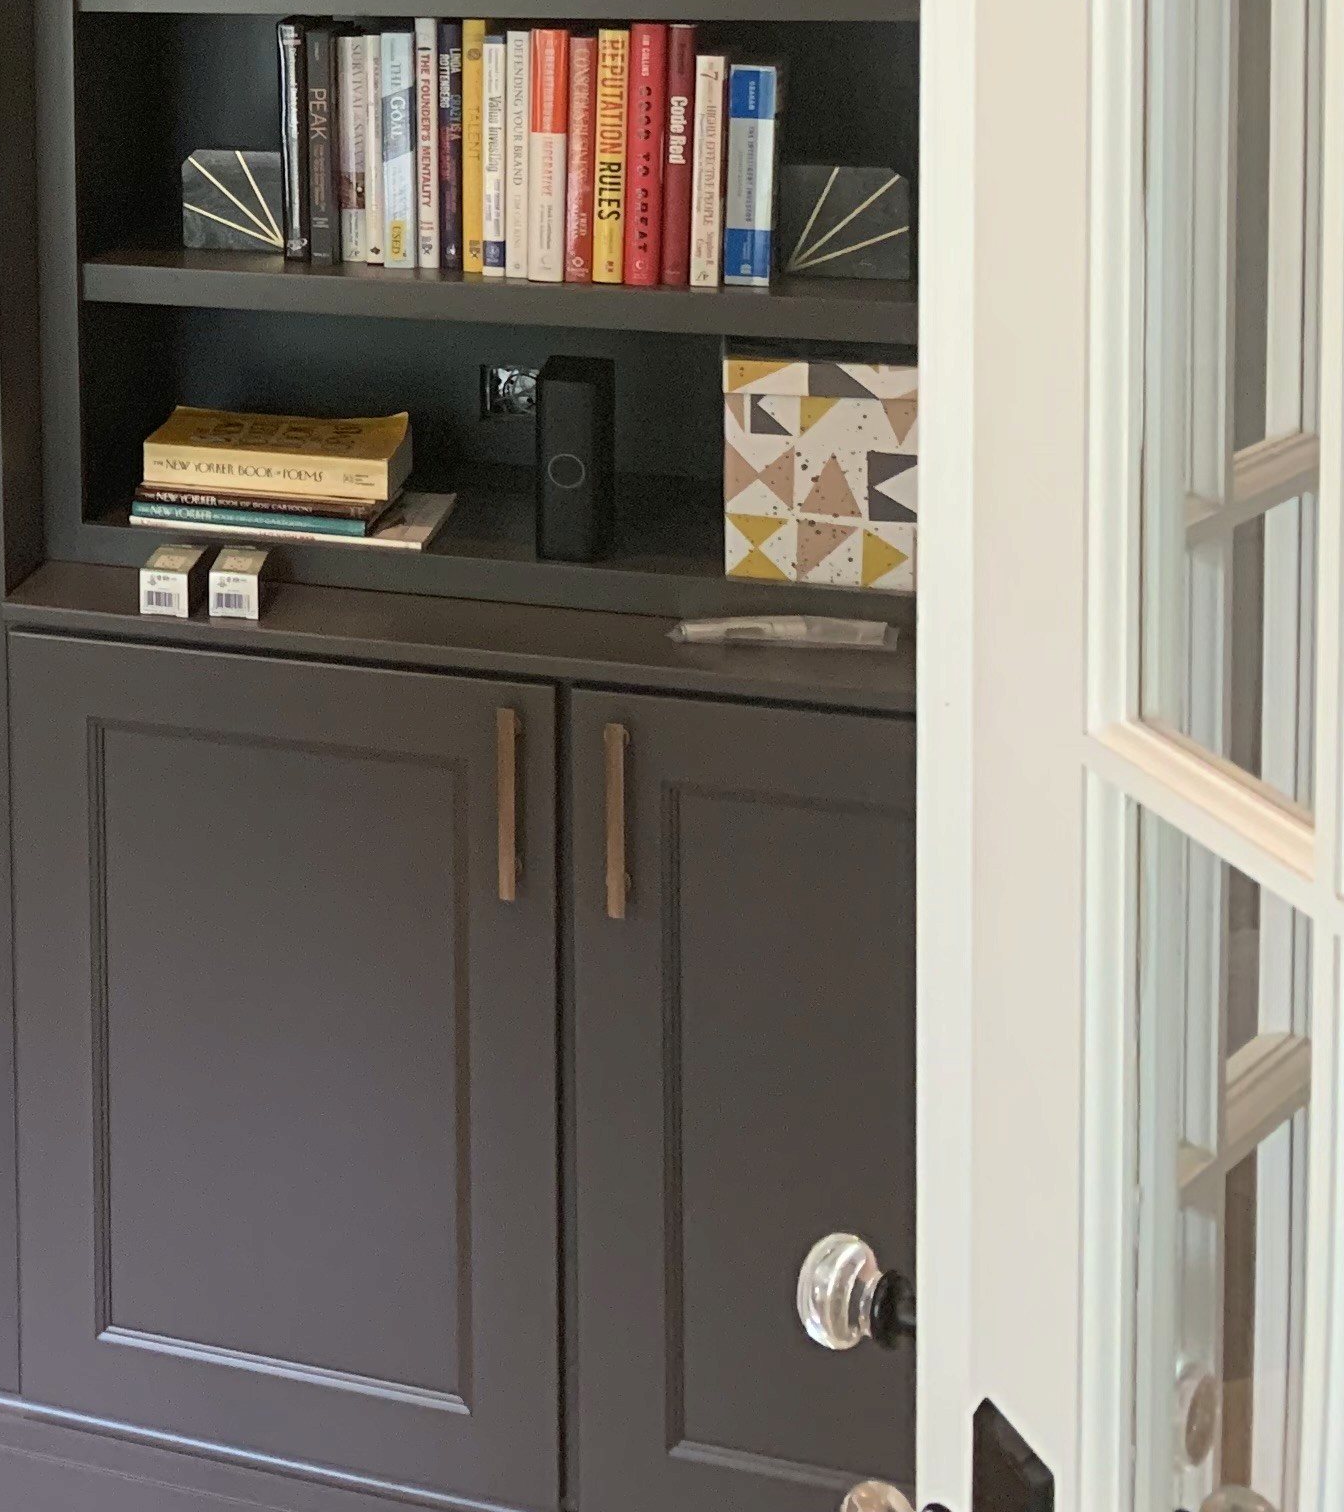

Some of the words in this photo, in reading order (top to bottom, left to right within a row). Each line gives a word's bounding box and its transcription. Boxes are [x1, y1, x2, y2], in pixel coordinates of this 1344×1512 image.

[421, 54, 431, 74] THE
[450, 48, 461, 73] LINDA
[513, 39, 525, 107] DEFENDING
[699, 71, 720, 81] 7
[440, 54, 450, 109] ROTTENBERG
[600, 38, 625, 155] REPUTATION
[309, 89, 328, 140] PEAK
[421, 78, 432, 141] FOUNDER'S
[488, 95, 502, 125] Value
[513, 110, 524, 142] YOUR
[637, 86, 652, 141] GOOD
[671, 95, 688, 134] Code
[706, 105, 717, 138] HIGHLY
[468, 105, 480, 161] TALENT
[669, 135, 687, 165] Red
[422, 145, 432, 208] MENTALITY
[512, 145, 524, 186] BRAND
[637, 152, 651, 177] TO
[704, 140, 716, 187] EFFECTIVE
[598, 161, 622, 221] RULES
[703, 191, 715, 226] PEOPLE
[391, 225, 402, 255] USED
[634, 188, 649, 253] GREAT
[165, 459, 191, 471] NEW
[191, 462, 234, 475] YORKER
[238, 465, 274, 478] BOOK
[282, 468, 324, 483] POEMS
[151, 505, 172, 517] NEW
[174, 507, 213, 521] YORKER
